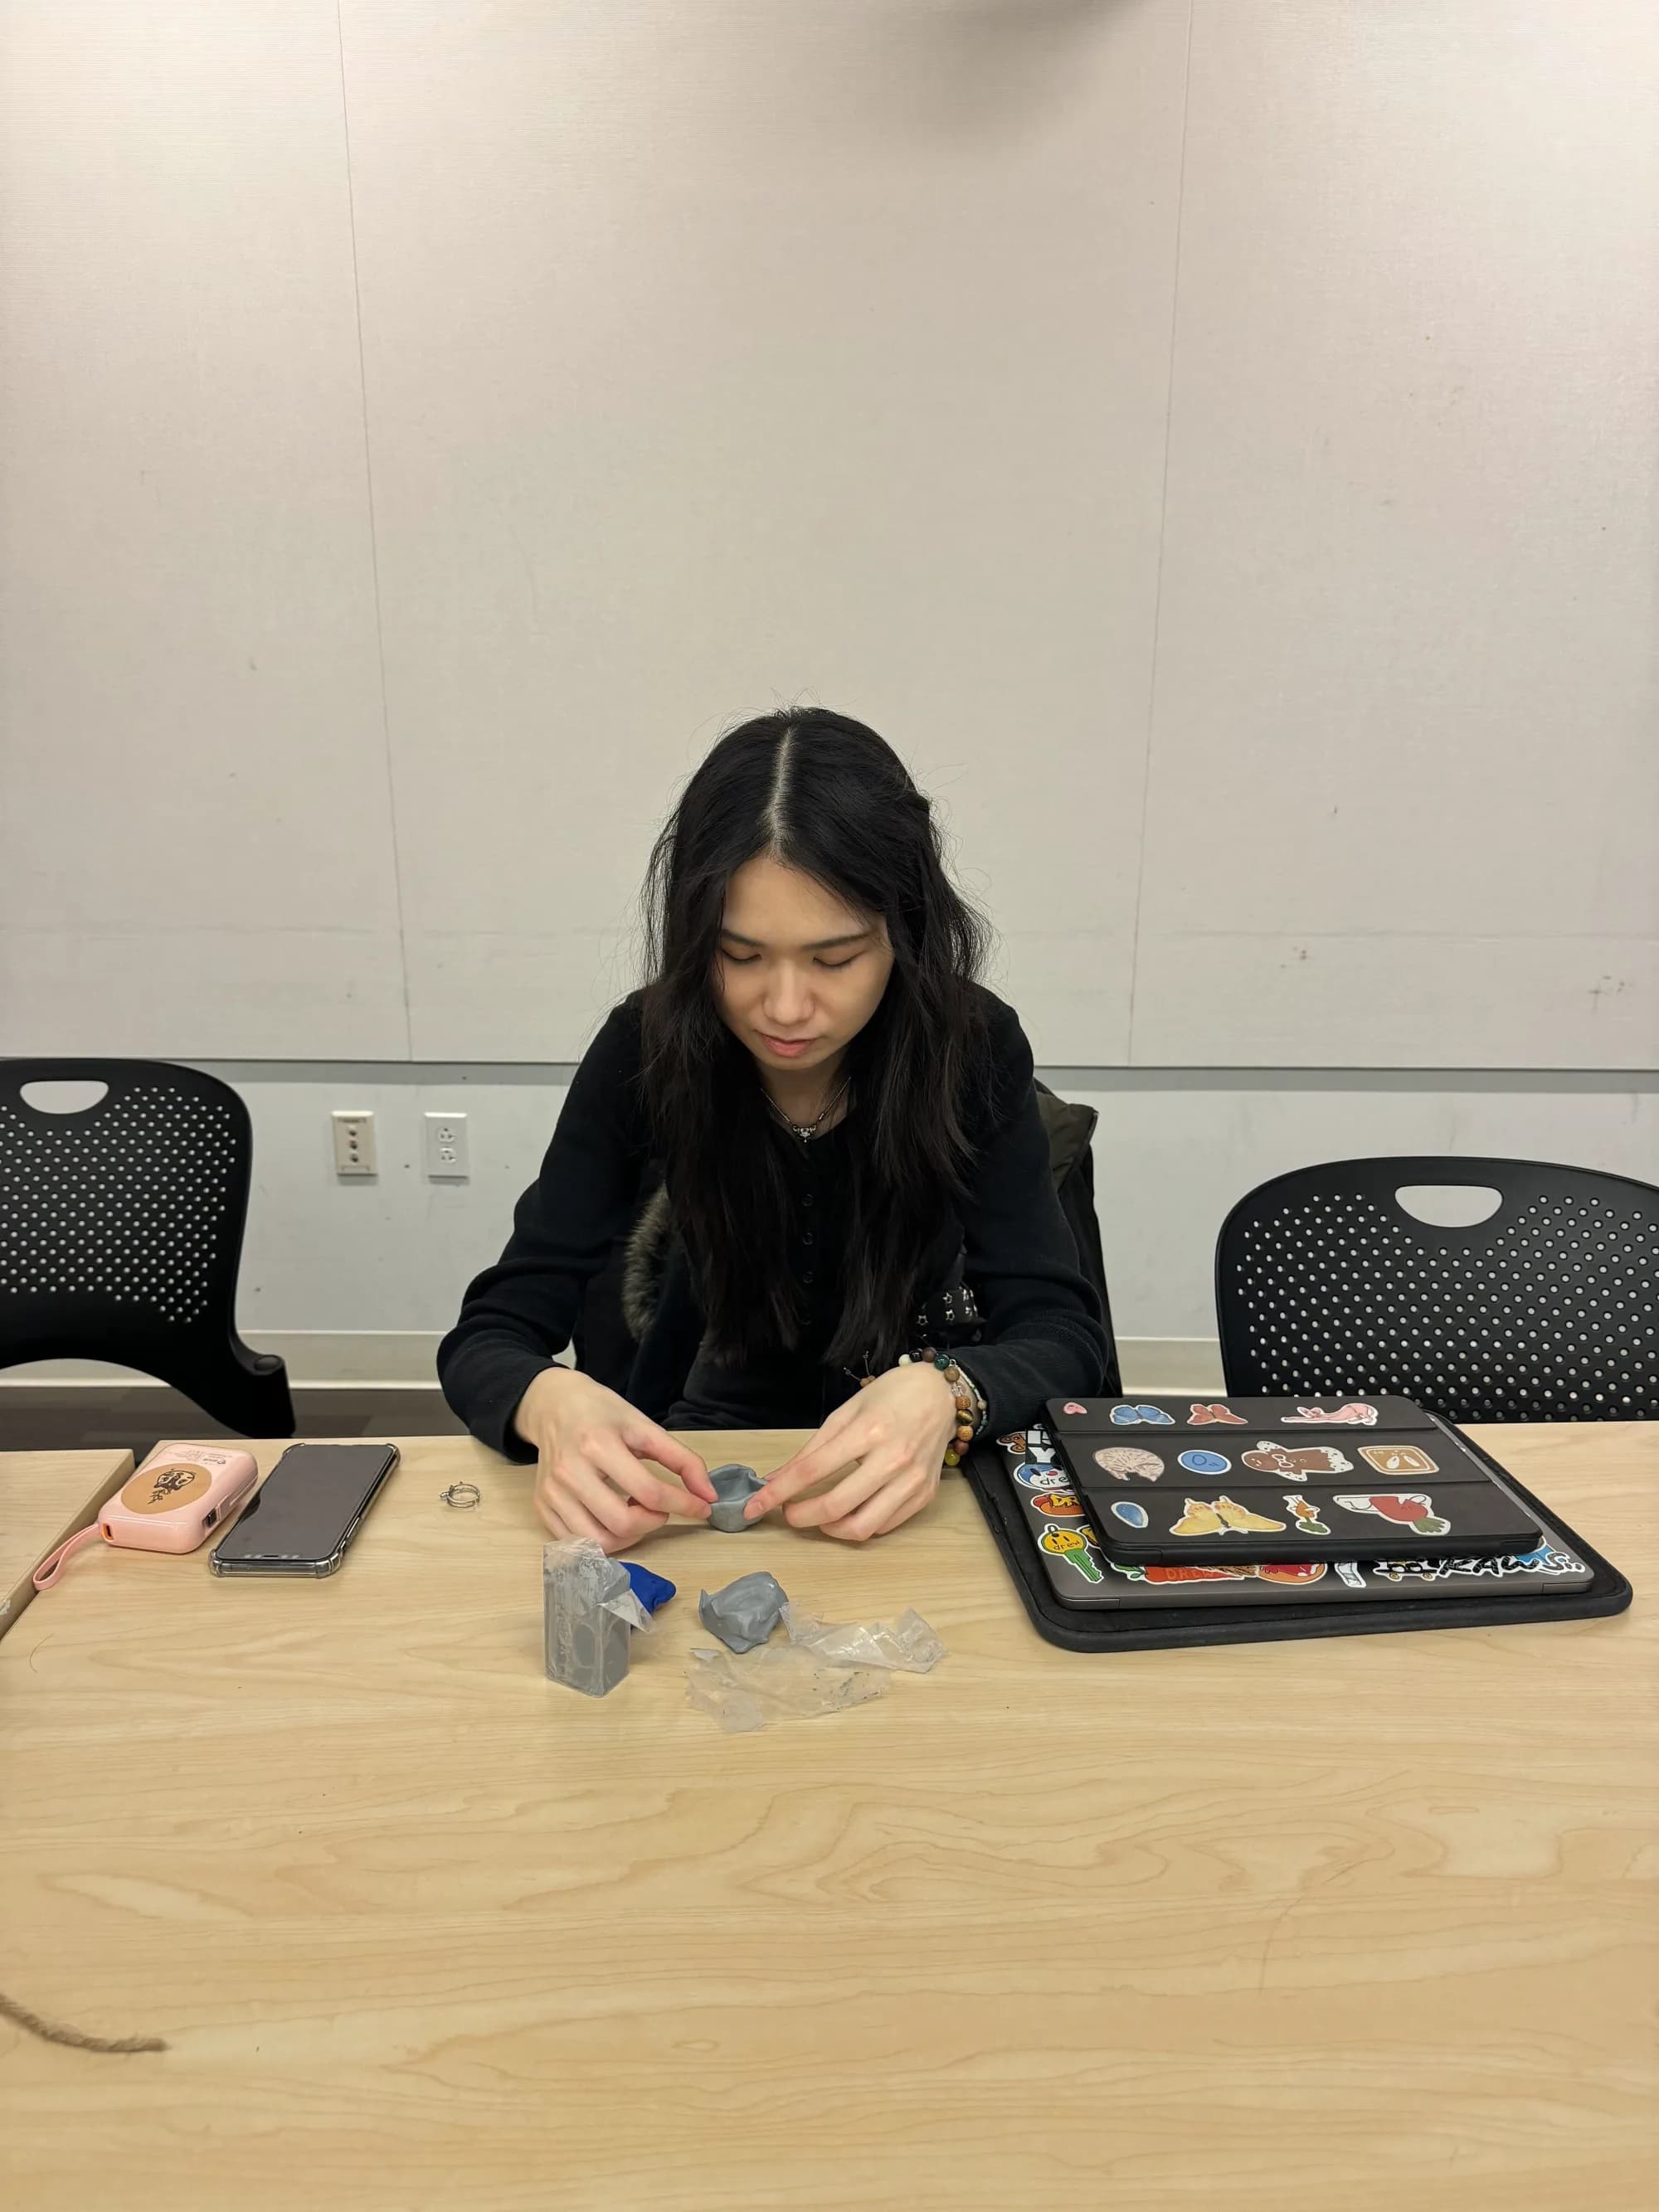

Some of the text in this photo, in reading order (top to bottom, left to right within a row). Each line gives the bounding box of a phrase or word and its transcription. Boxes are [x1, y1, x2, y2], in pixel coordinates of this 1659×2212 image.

[1040, 1476, 1069, 1485] dre
[1053, 1540, 1080, 1550] drew
[1165, 1568, 1214, 1579] DREW
